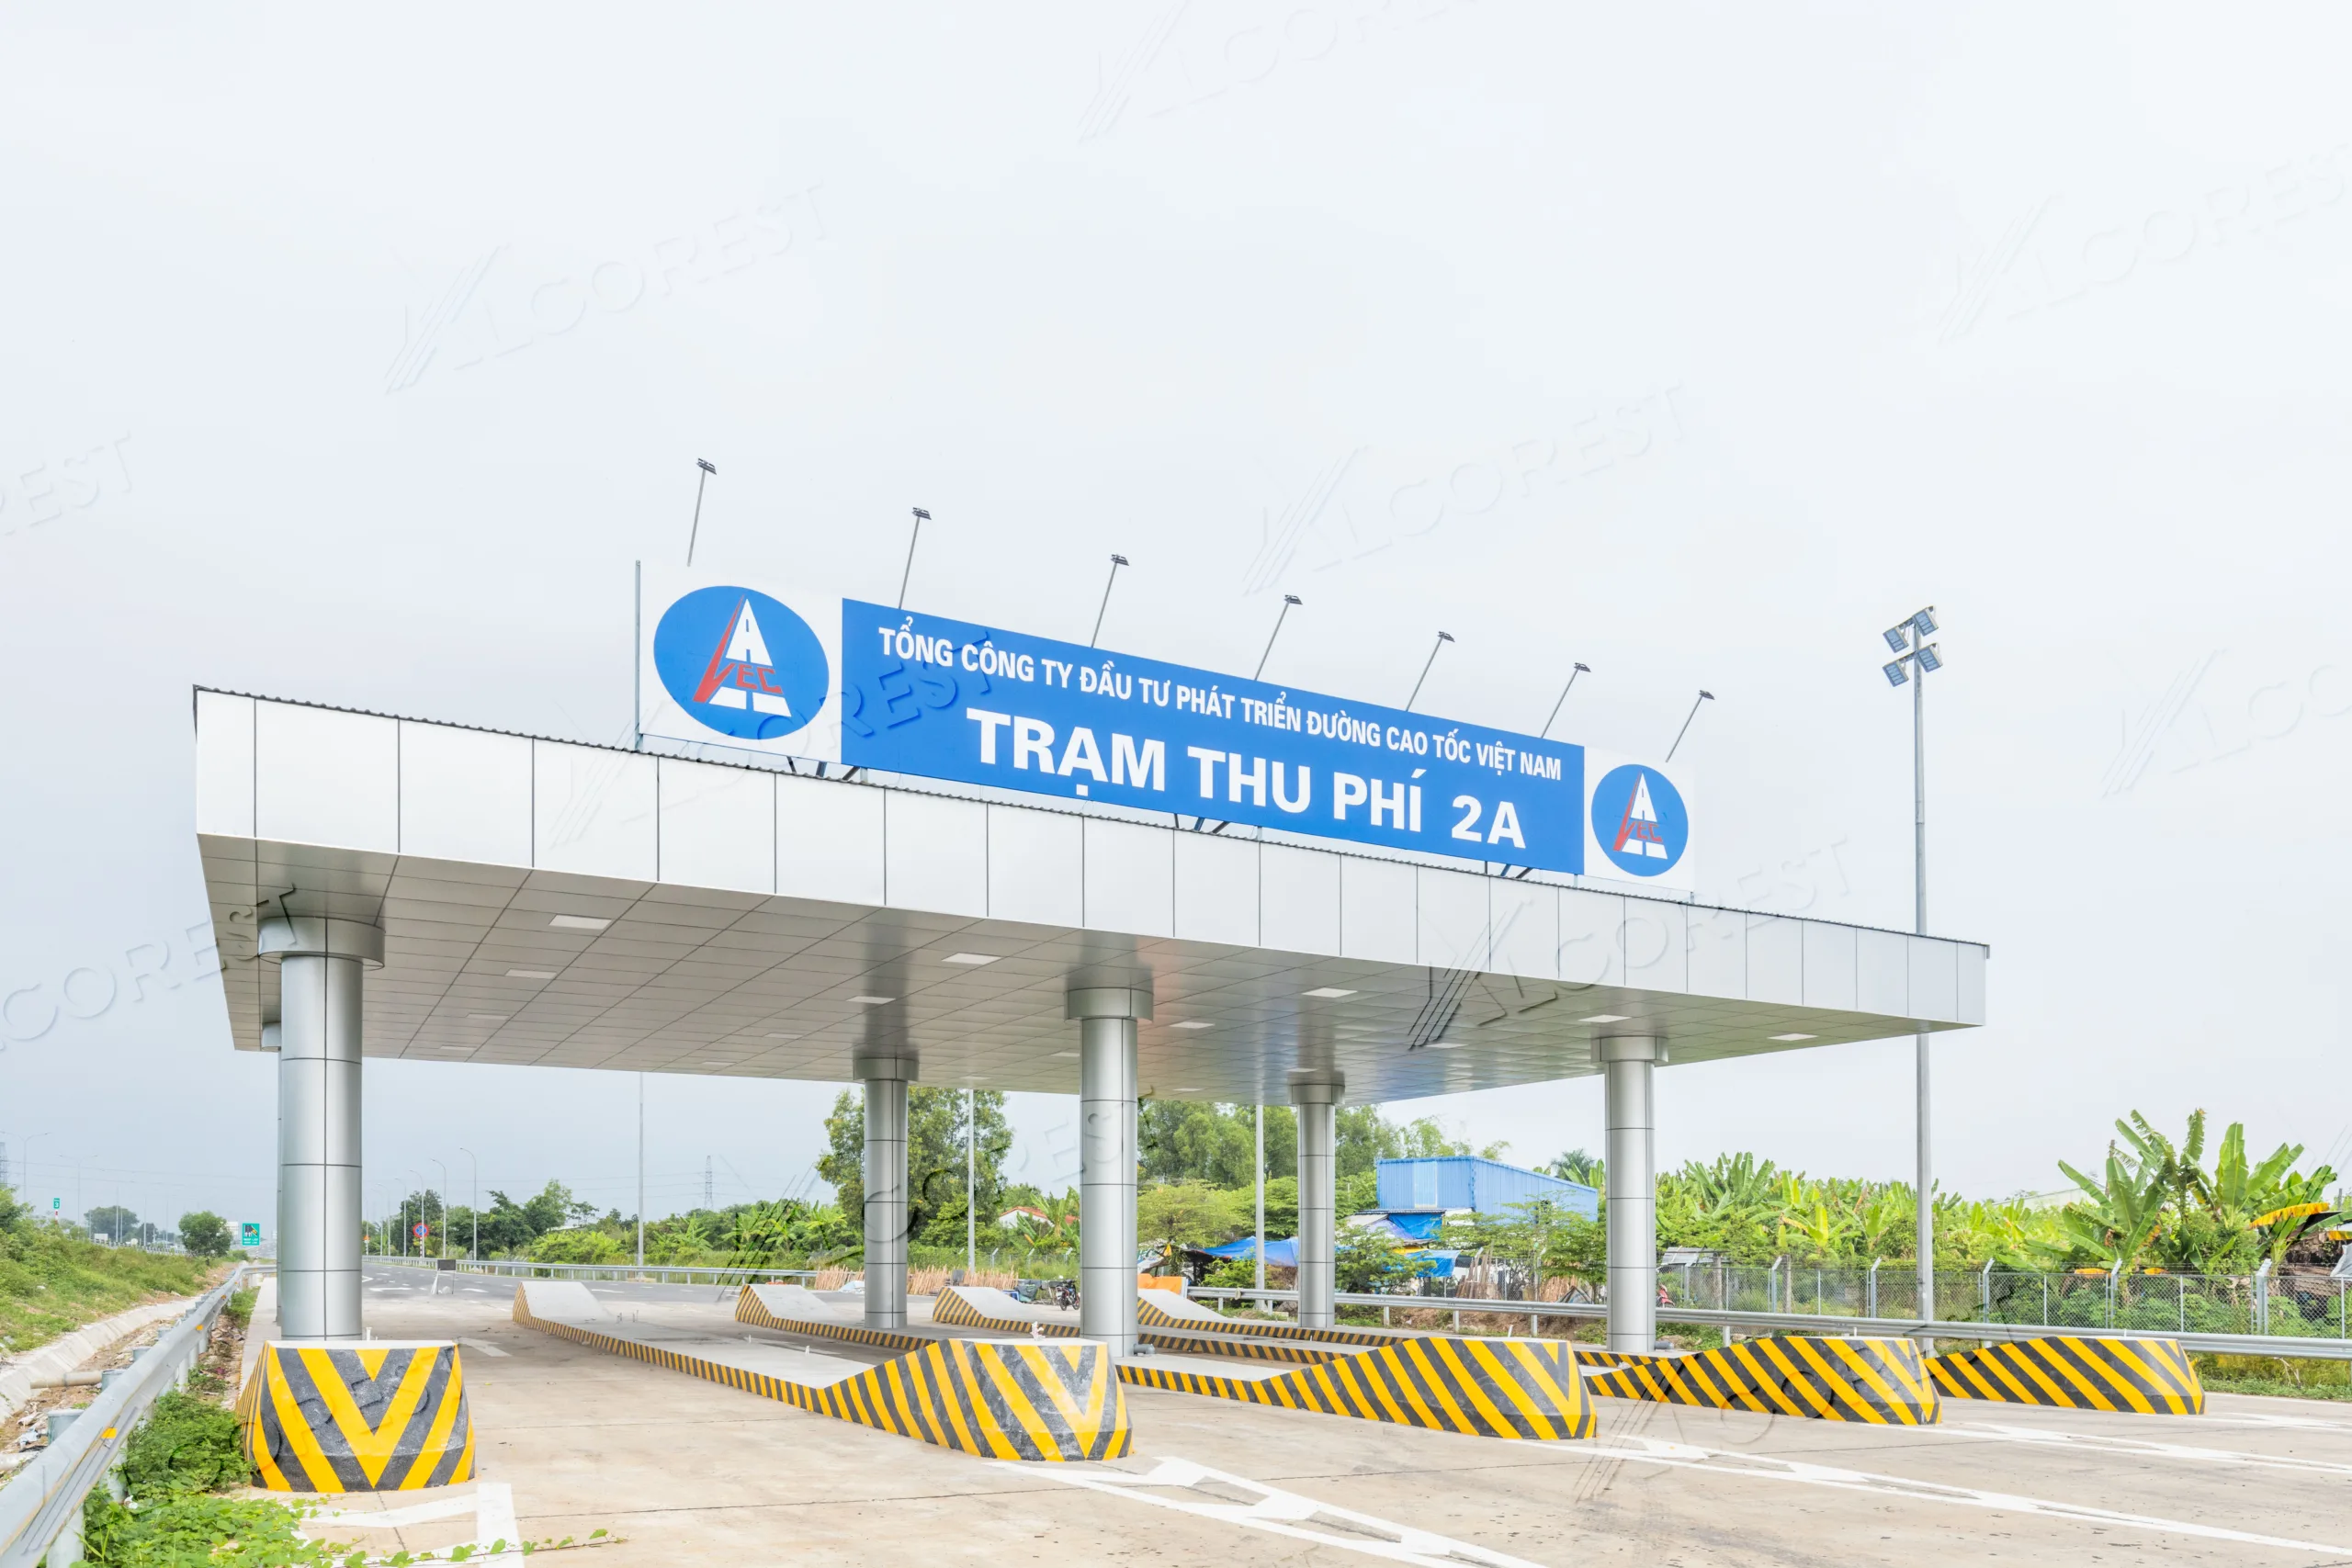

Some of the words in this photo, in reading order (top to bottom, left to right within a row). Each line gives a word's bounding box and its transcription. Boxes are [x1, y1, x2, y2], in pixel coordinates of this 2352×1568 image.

[879, 615, 954, 667] TỔNG
[962, 641, 1035, 682] CÔNG
[1042, 659, 1074, 689] TY
[1079, 660, 1132, 700] ĐẦU
[1138, 677, 1171, 707] TƯ
[1177, 684, 1236, 719] PHÁT
[1241, 692, 1302, 732] TRIỂN
[1306, 709, 1381, 748] ĐƯỜNG
[1386, 726, 1429, 756] CAO
[1433, 728, 1471, 764] TỐC
[1476, 740, 1516, 776] VIỆT
[1521, 751, 1561, 781] NAM
[967, 706, 1166, 797] TRẠM
[1188, 745, 1312, 814] THU
[1334, 768, 1427, 833] PHÍ
[1451, 795, 1526, 849] 2A
